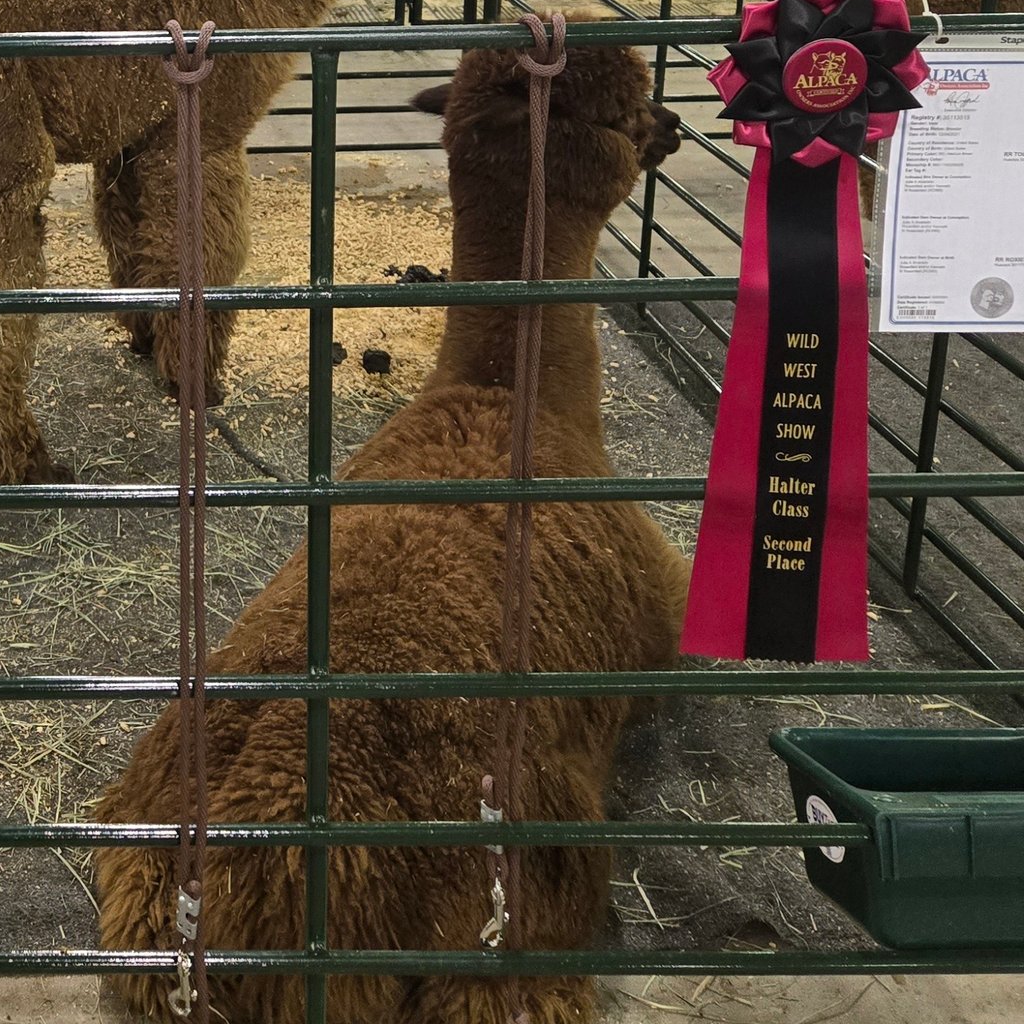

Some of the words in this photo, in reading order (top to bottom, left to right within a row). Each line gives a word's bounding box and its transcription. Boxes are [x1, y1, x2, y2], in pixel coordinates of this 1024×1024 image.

[793, 73, 858, 88] ALPACA
[787, 333, 819, 349] WILD
[784, 363, 817, 378] WEST
[773, 393, 822, 409] ALPACA
[776, 423, 815, 440] SHOW
[769, 476, 815, 495] Halter
[773, 500, 809, 518] Class
[763, 535, 812, 552] Second
[767, 554, 806, 571] Place
